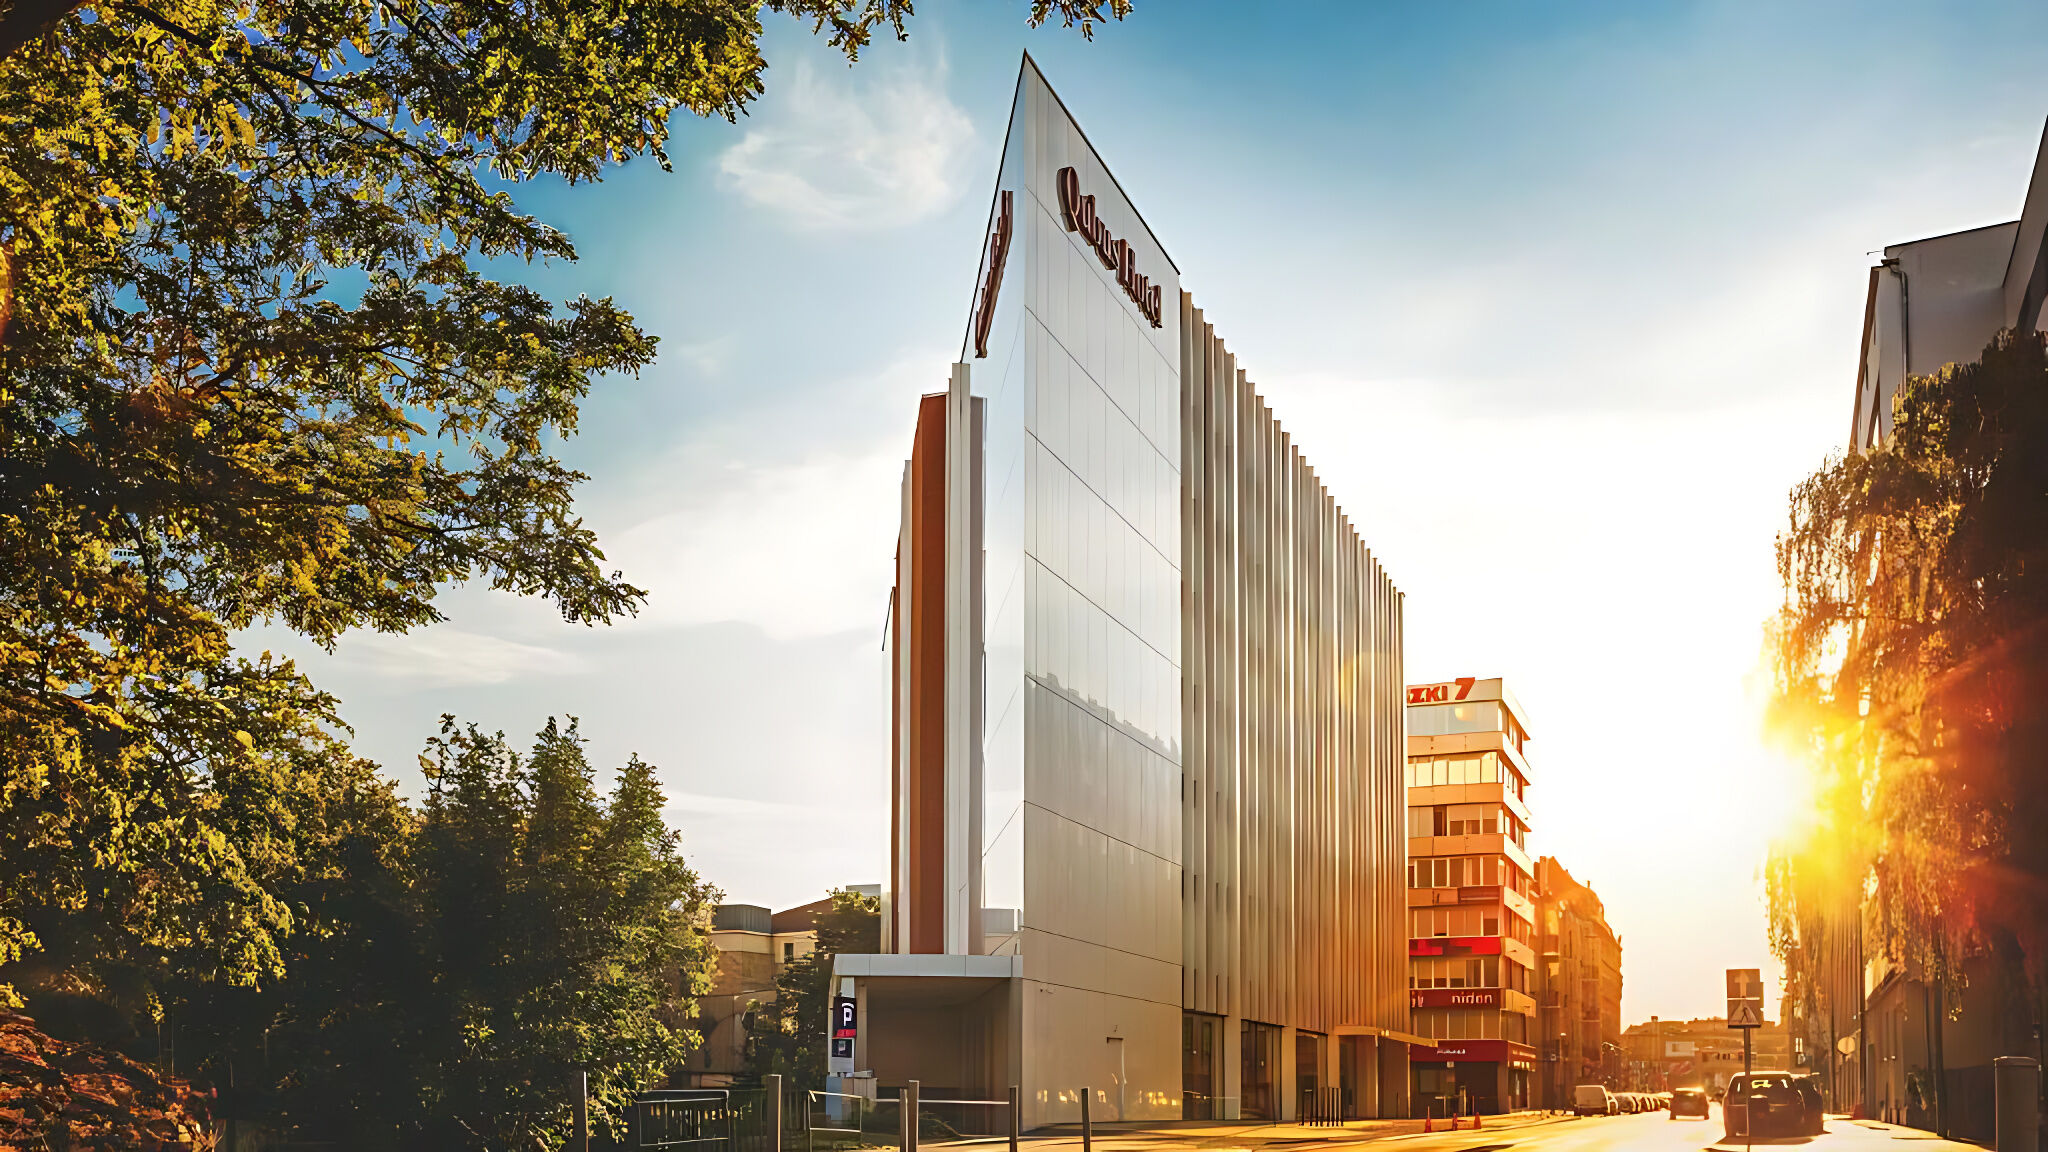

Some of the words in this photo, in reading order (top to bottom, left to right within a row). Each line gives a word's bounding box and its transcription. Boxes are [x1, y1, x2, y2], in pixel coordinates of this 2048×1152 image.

[1407, 685, 1448, 704] ZKI
[1455, 677, 1475, 700] 7
[843, 1007, 853, 1027] P
